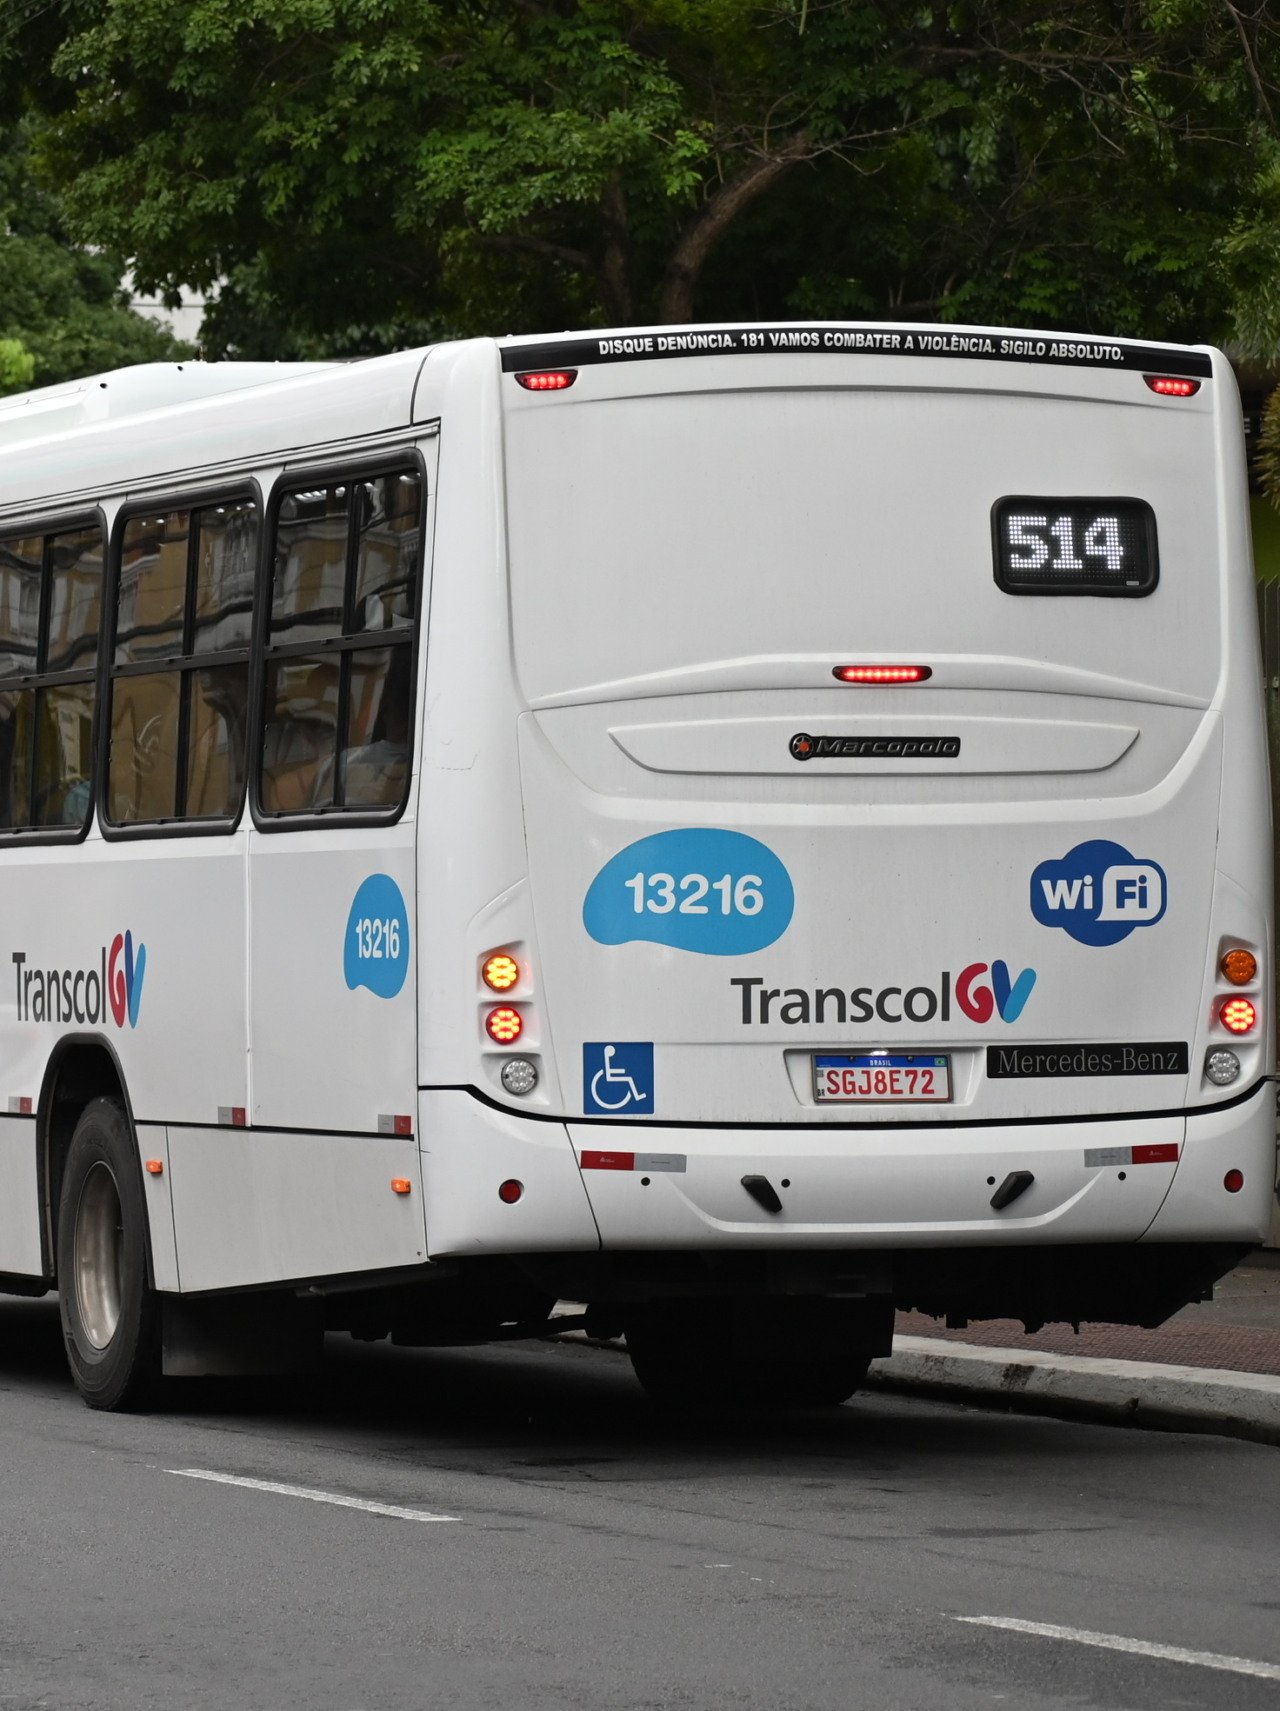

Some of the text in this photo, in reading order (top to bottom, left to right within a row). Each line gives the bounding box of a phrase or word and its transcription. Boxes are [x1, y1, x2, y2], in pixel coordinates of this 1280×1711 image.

[598, 332, 1125, 361] DISQUE DENÚNCIA. 181 VAMOS COMBATER A VIOLÊNCIA. SIGILO ABSOLUTO.
[1008, 515, 1124, 570] 514
[816, 739, 959, 756] Marcopolo
[624, 872, 765, 916] 13216
[355, 918, 400, 959] 13216
[997, 1047, 1179, 1074] Mercedes-Benz
[826, 1069, 935, 1095] SGJ8E72
